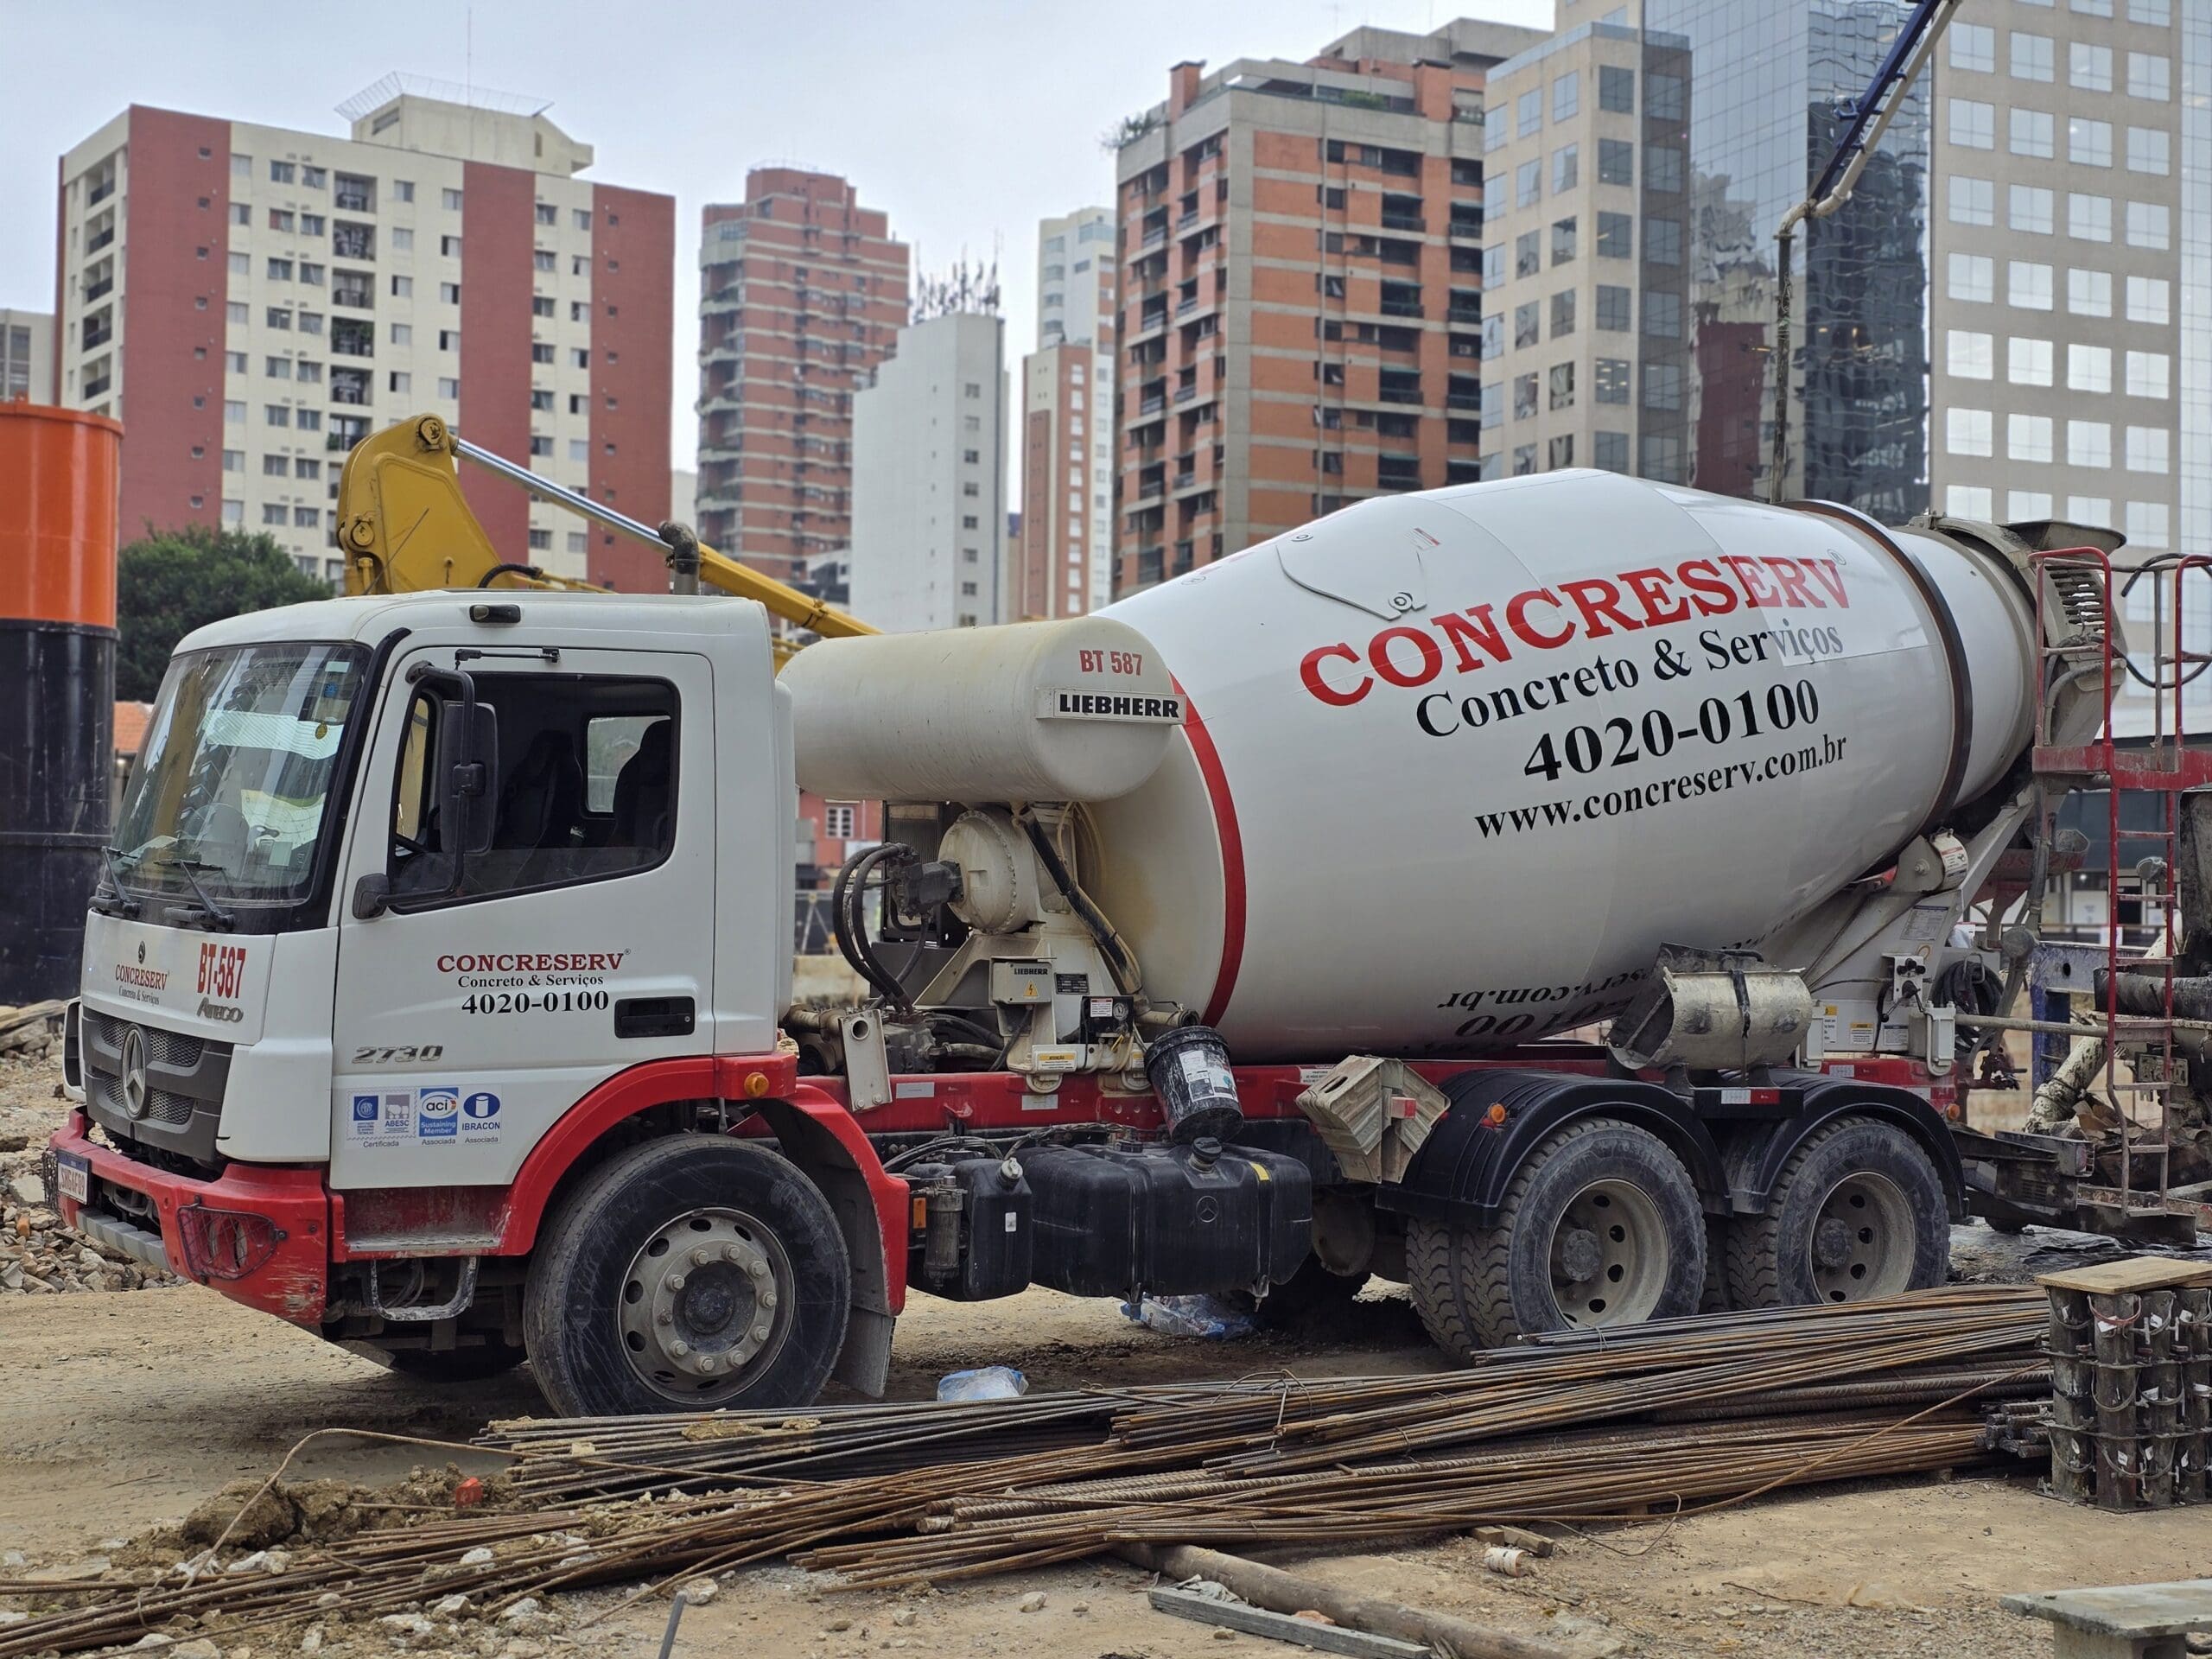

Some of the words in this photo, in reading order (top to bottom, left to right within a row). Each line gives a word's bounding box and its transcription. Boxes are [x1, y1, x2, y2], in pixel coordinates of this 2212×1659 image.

[1300, 555, 1850, 707] CONCRESERV
[1079, 650, 1104, 672] BT
[1110, 651, 1142, 677] 587
[1416, 654, 1640, 737] Concreto
[1654, 639, 1692, 681] &
[1699, 617, 1844, 671] Serviços
[1059, 694, 1179, 719] LIEBHERR
[1524, 679, 1820, 782] 4020-0100
[1474, 734, 1847, 839] www.concreserv.com.br
[197, 942, 246, 999] BT-587
[437, 953, 624, 973] CONCRESERV
[115, 964, 168, 991] CONCRESERV
[458, 976, 524, 988] Concreto
[529, 976, 541, 987] &
[546, 974, 604, 988] Serviços
[461, 991, 609, 1014] 4020-0100
[352, 1046, 443, 1065] 2730
[426, 1099, 448, 1111] aci
[461, 1122, 500, 1131] IBRACON
